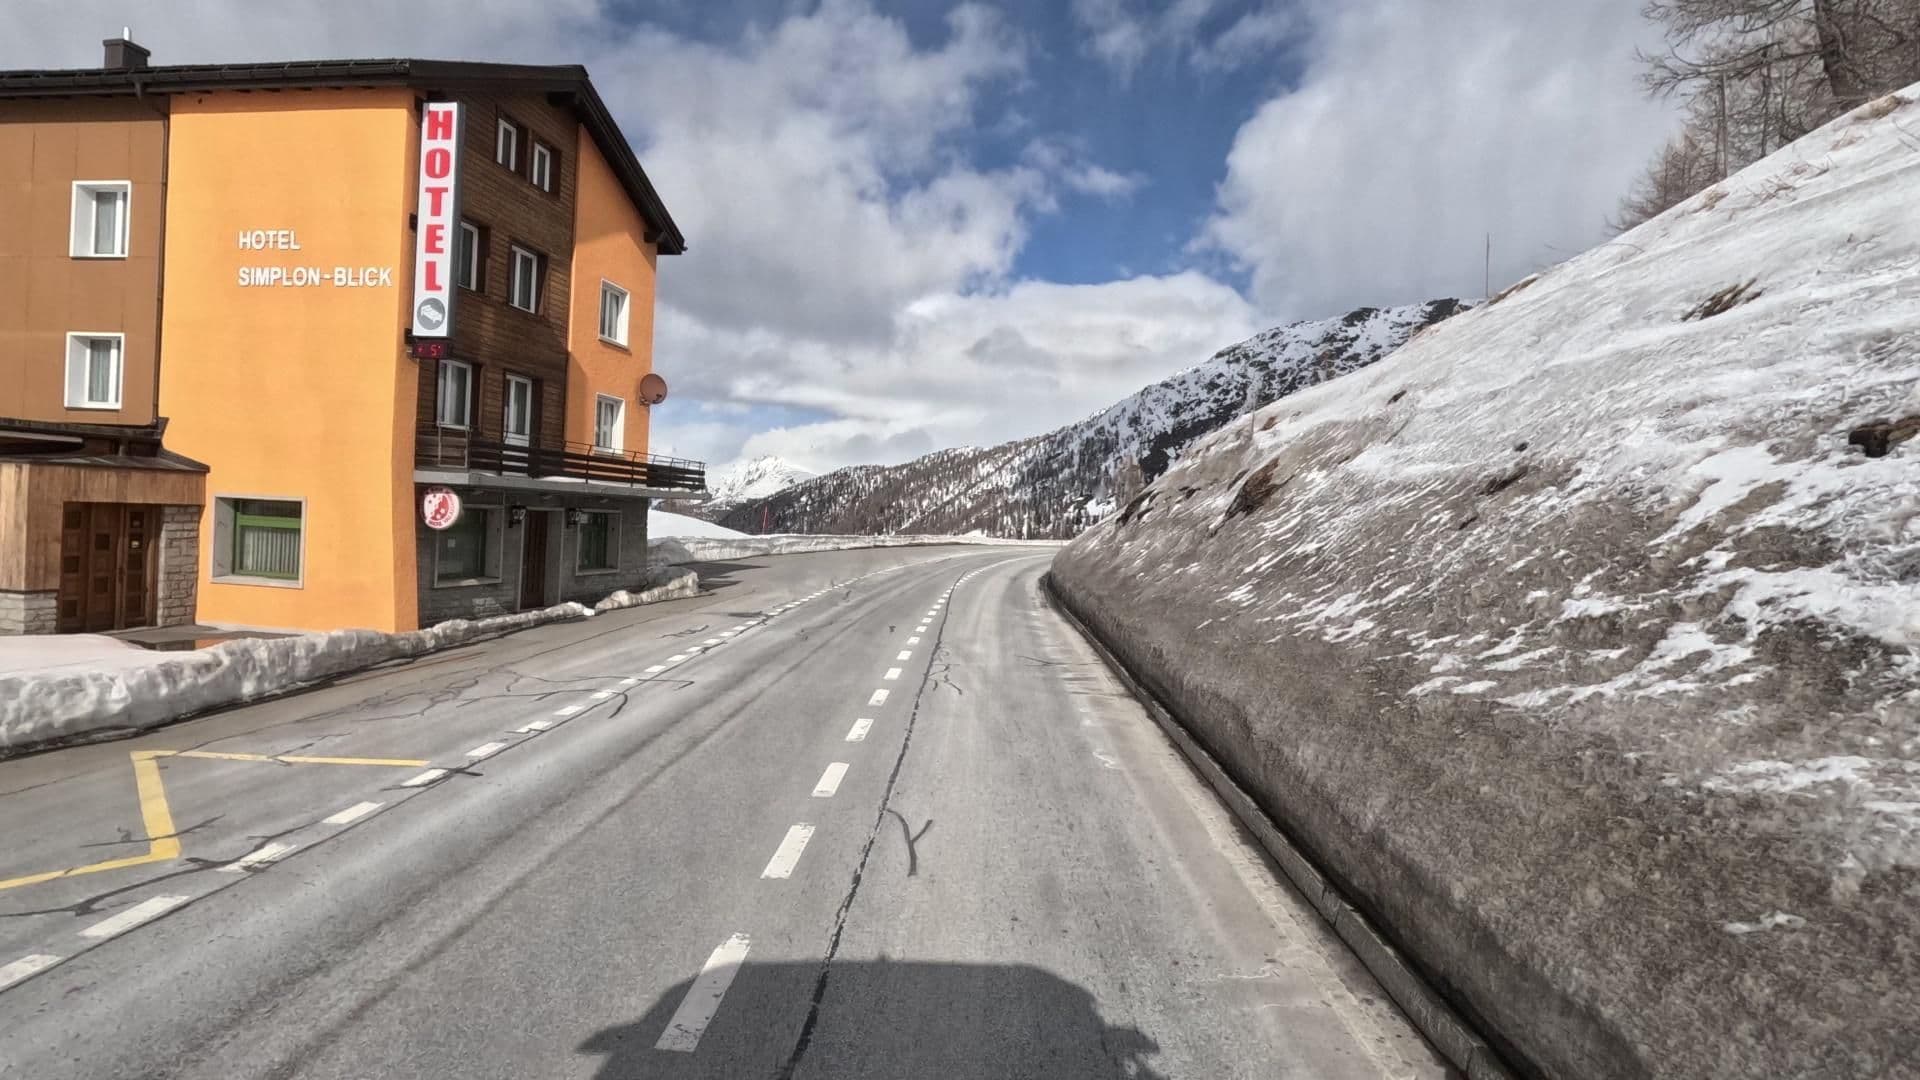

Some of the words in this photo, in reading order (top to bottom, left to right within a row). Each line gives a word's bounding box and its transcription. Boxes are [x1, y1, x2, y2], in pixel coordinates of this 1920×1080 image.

[424, 110, 453, 292] HOTEL
[238, 230, 301, 250] HOTEL
[238, 266, 393, 287] SIMPLON-BLICK
